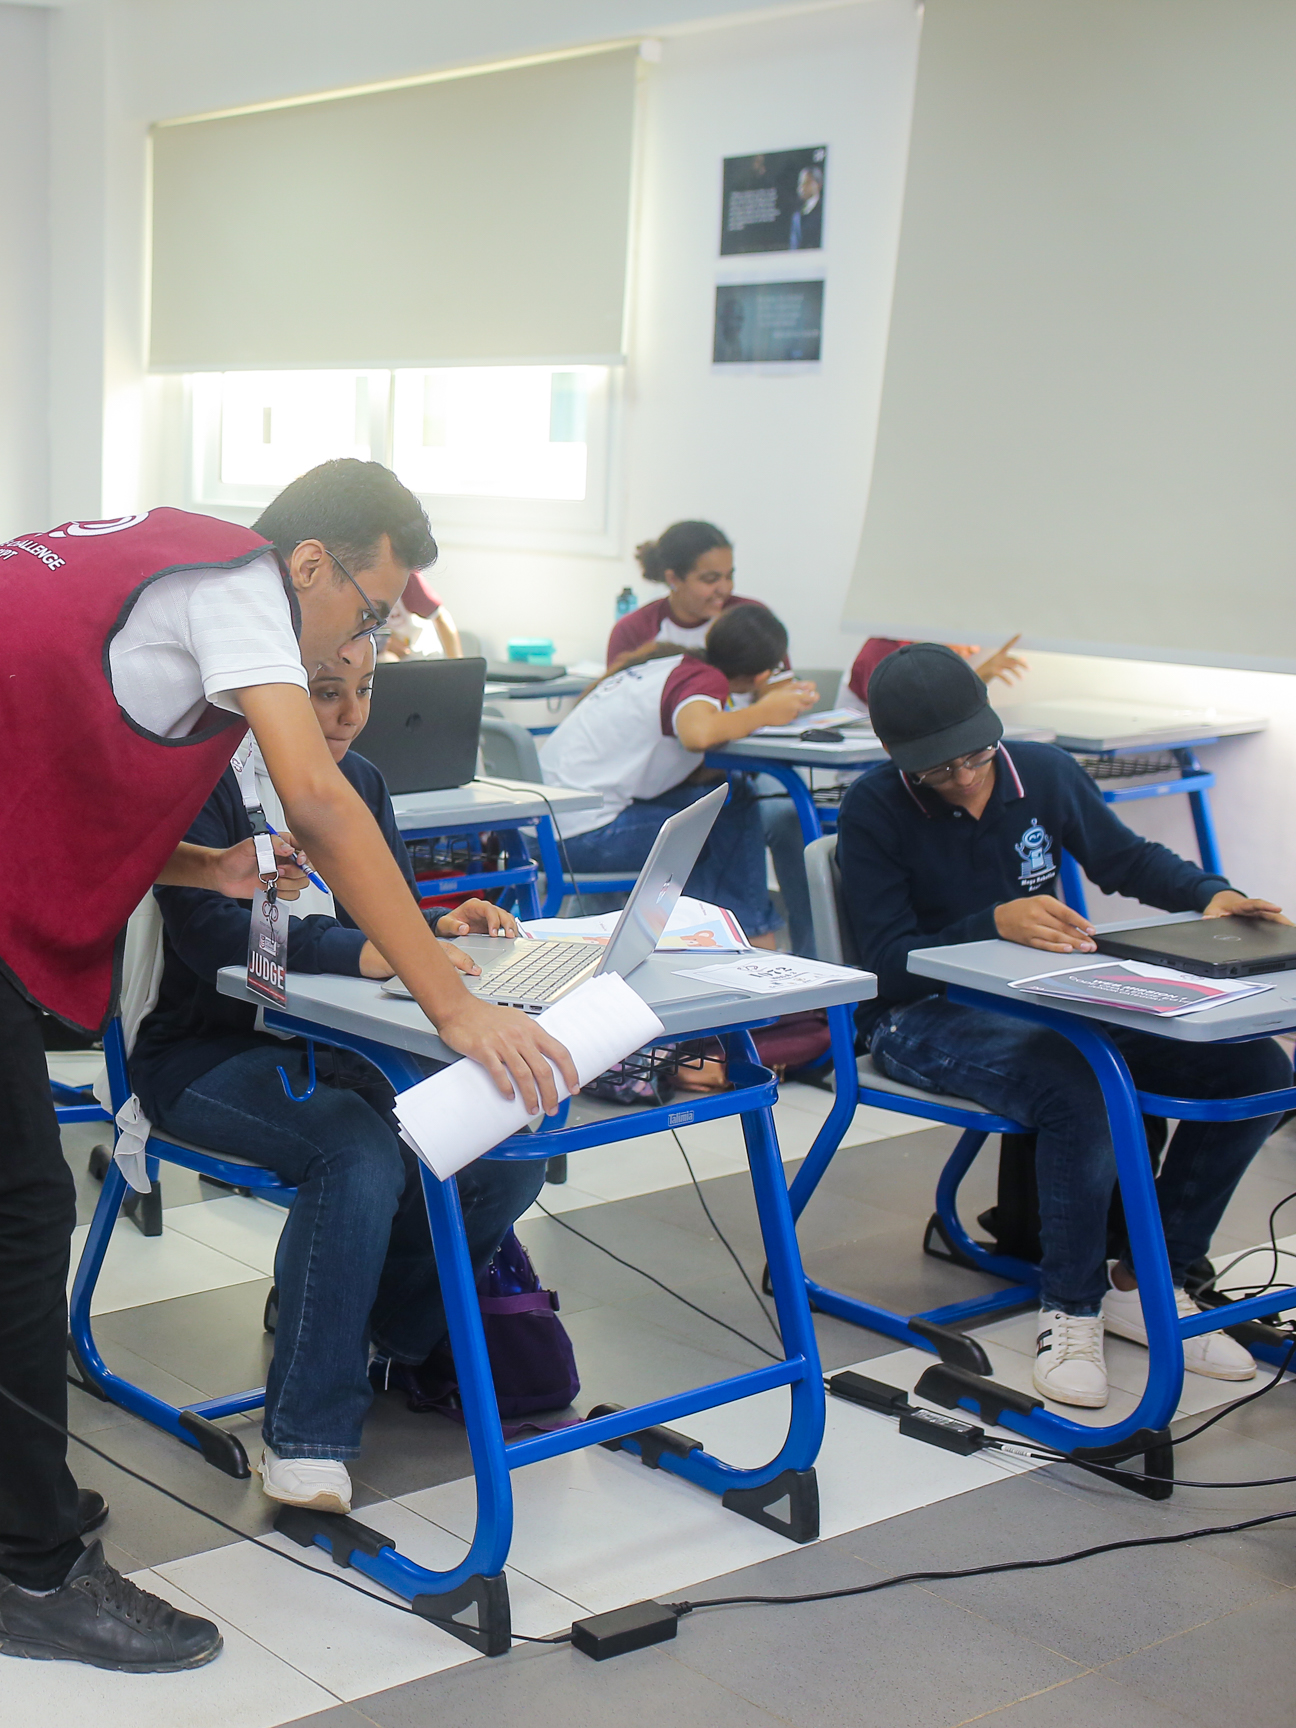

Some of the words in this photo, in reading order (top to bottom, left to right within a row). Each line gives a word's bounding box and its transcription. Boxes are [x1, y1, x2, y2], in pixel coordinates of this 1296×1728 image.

[1, 539, 66, 571] ALLENGE
[249, 950, 285, 991] JUDGE
[668, 1110, 694, 1126] Talimia
